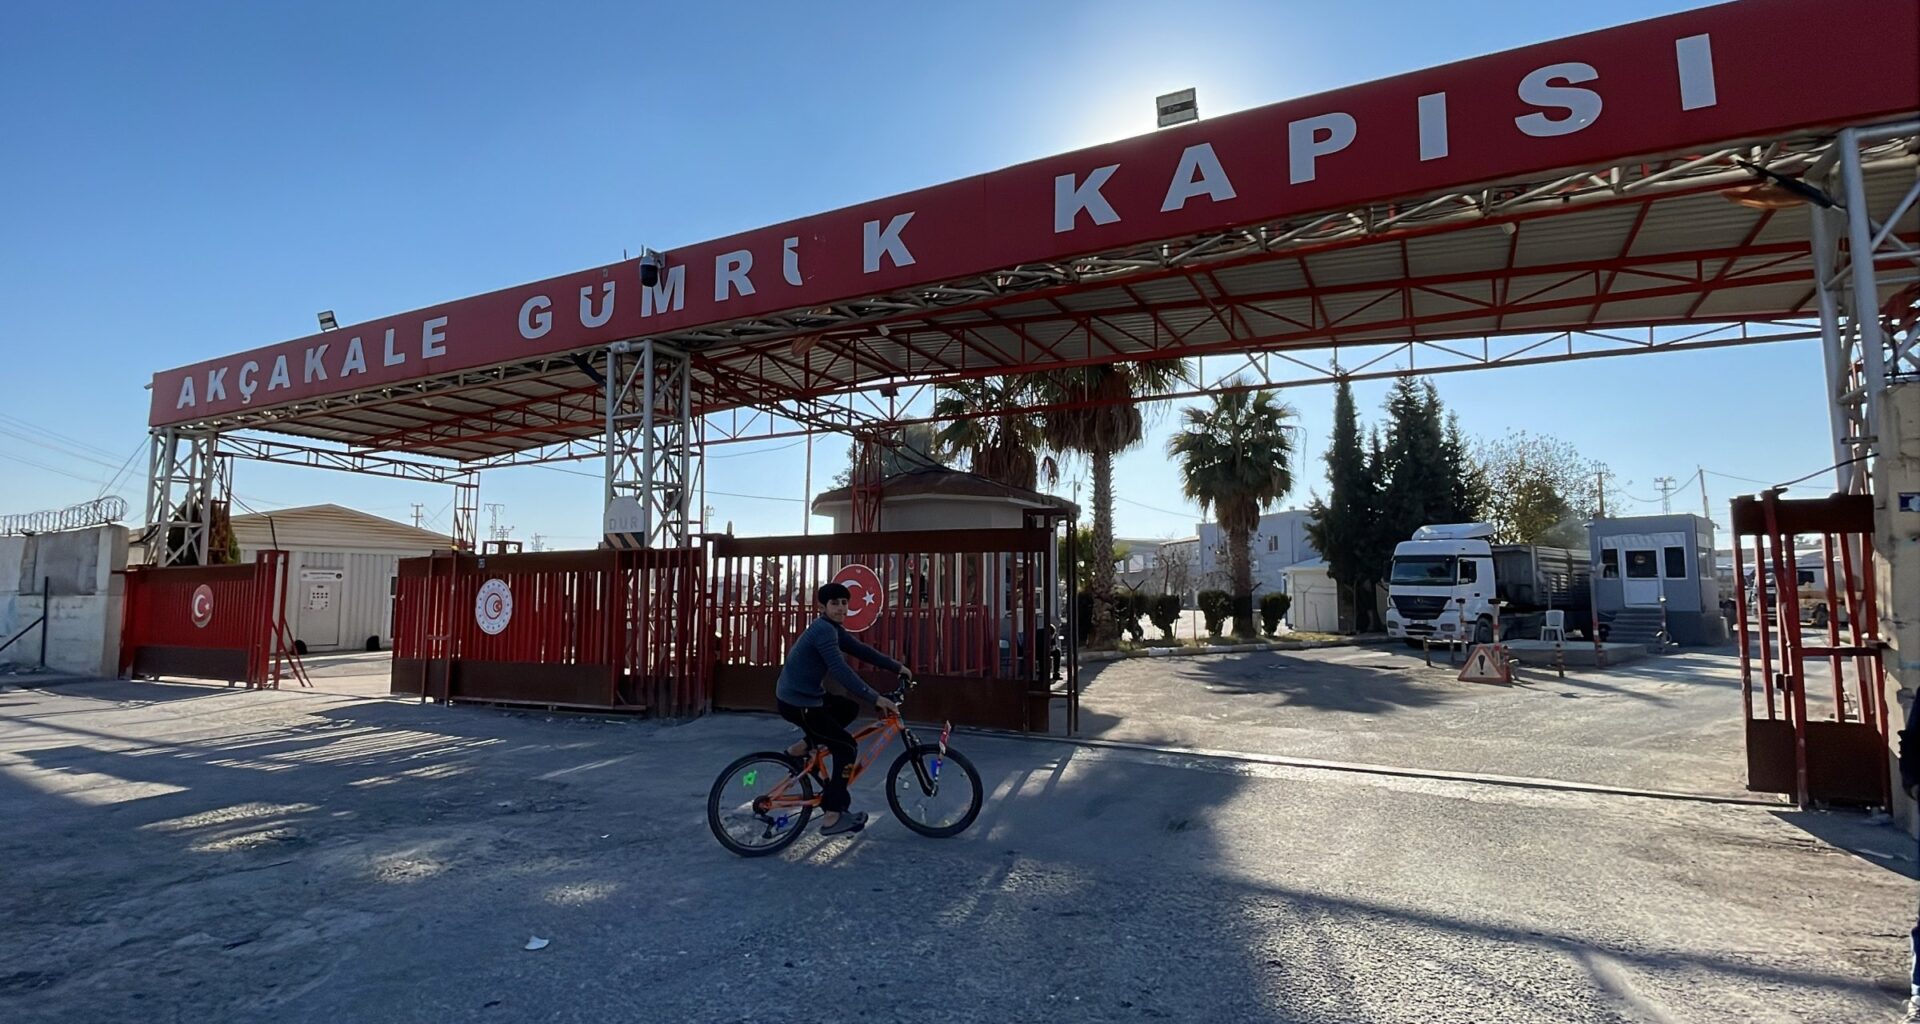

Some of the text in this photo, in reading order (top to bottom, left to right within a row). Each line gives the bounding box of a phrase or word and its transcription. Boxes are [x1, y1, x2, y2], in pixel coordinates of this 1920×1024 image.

[176, 315, 448, 409] AKÇAKALE
[1053, 32, 1718, 234] KAPISI
[609, 517, 638, 530] DUR
